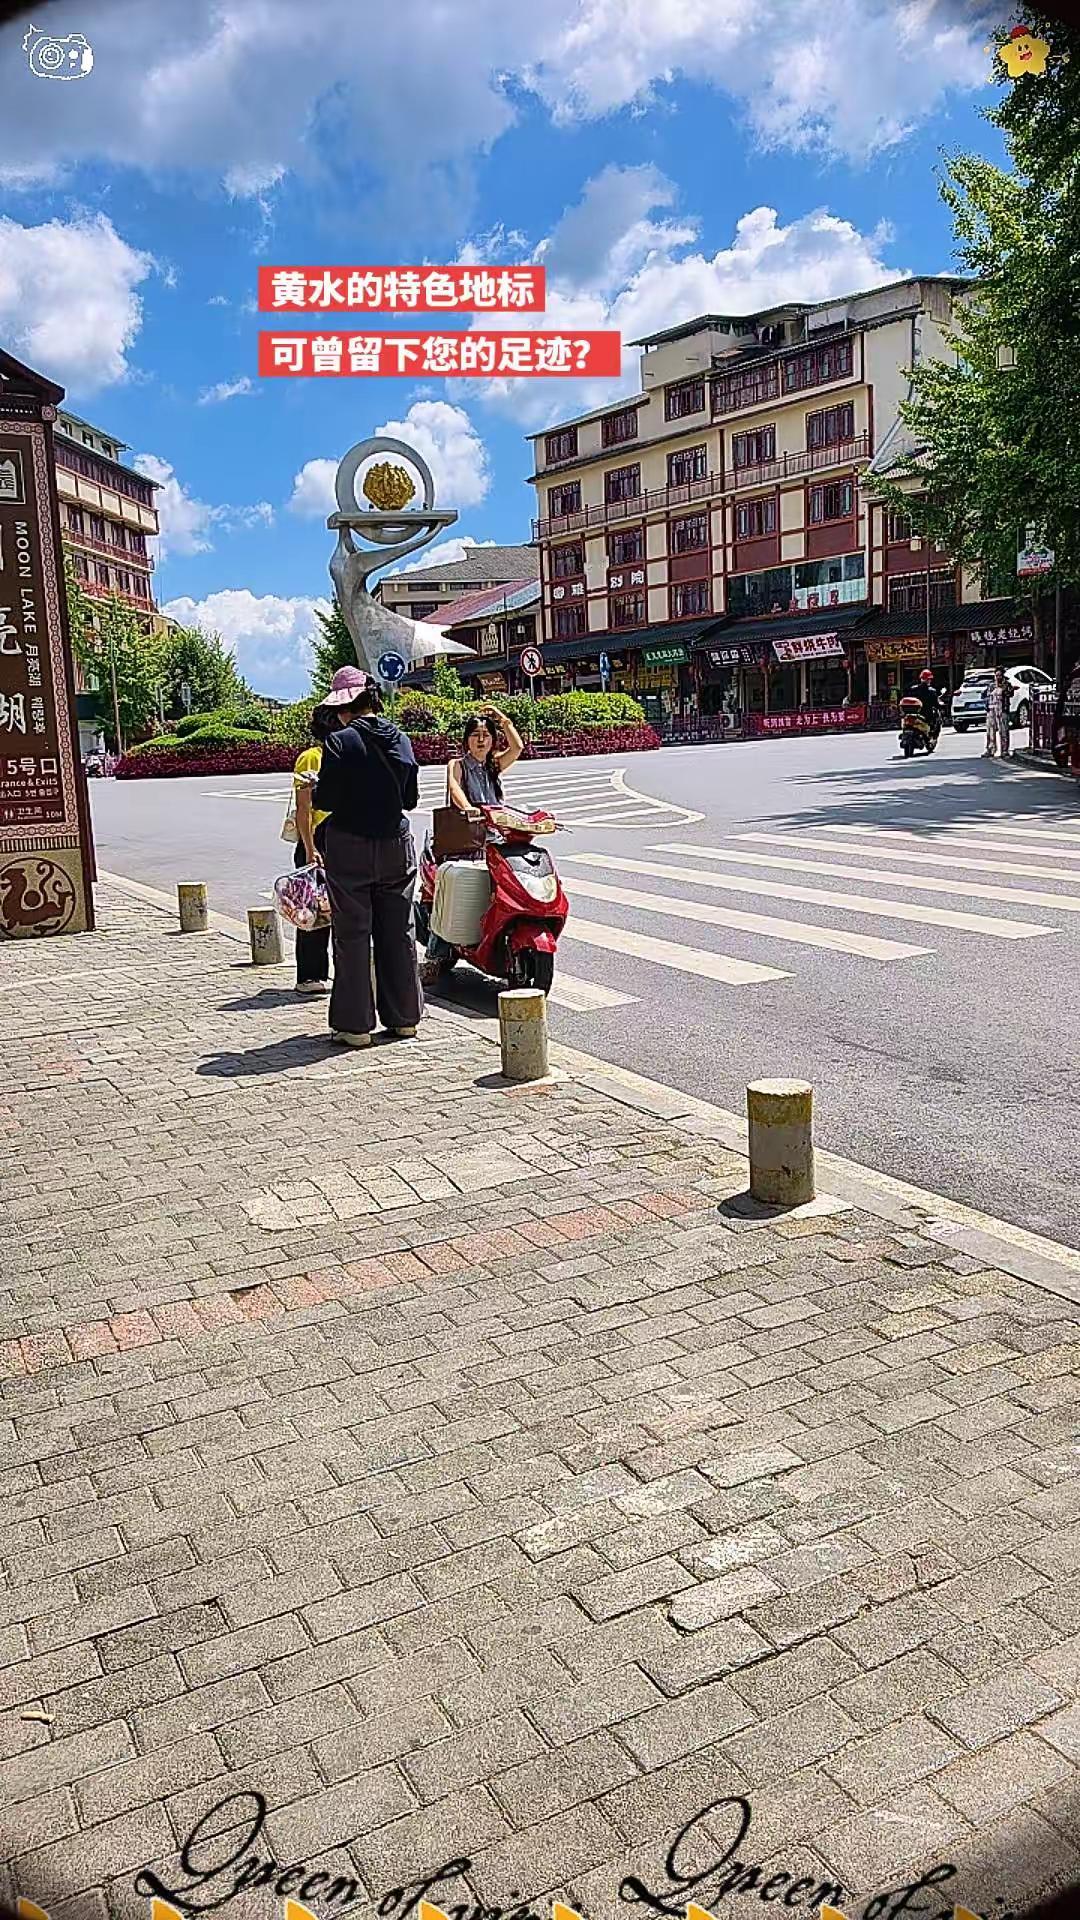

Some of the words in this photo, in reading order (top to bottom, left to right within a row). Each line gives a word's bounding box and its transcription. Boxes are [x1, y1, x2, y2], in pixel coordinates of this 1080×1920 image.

[15, 521, 32, 578] MOON
[20, 588, 37, 634] LAKE
[7, 757, 58, 776] 5号口
